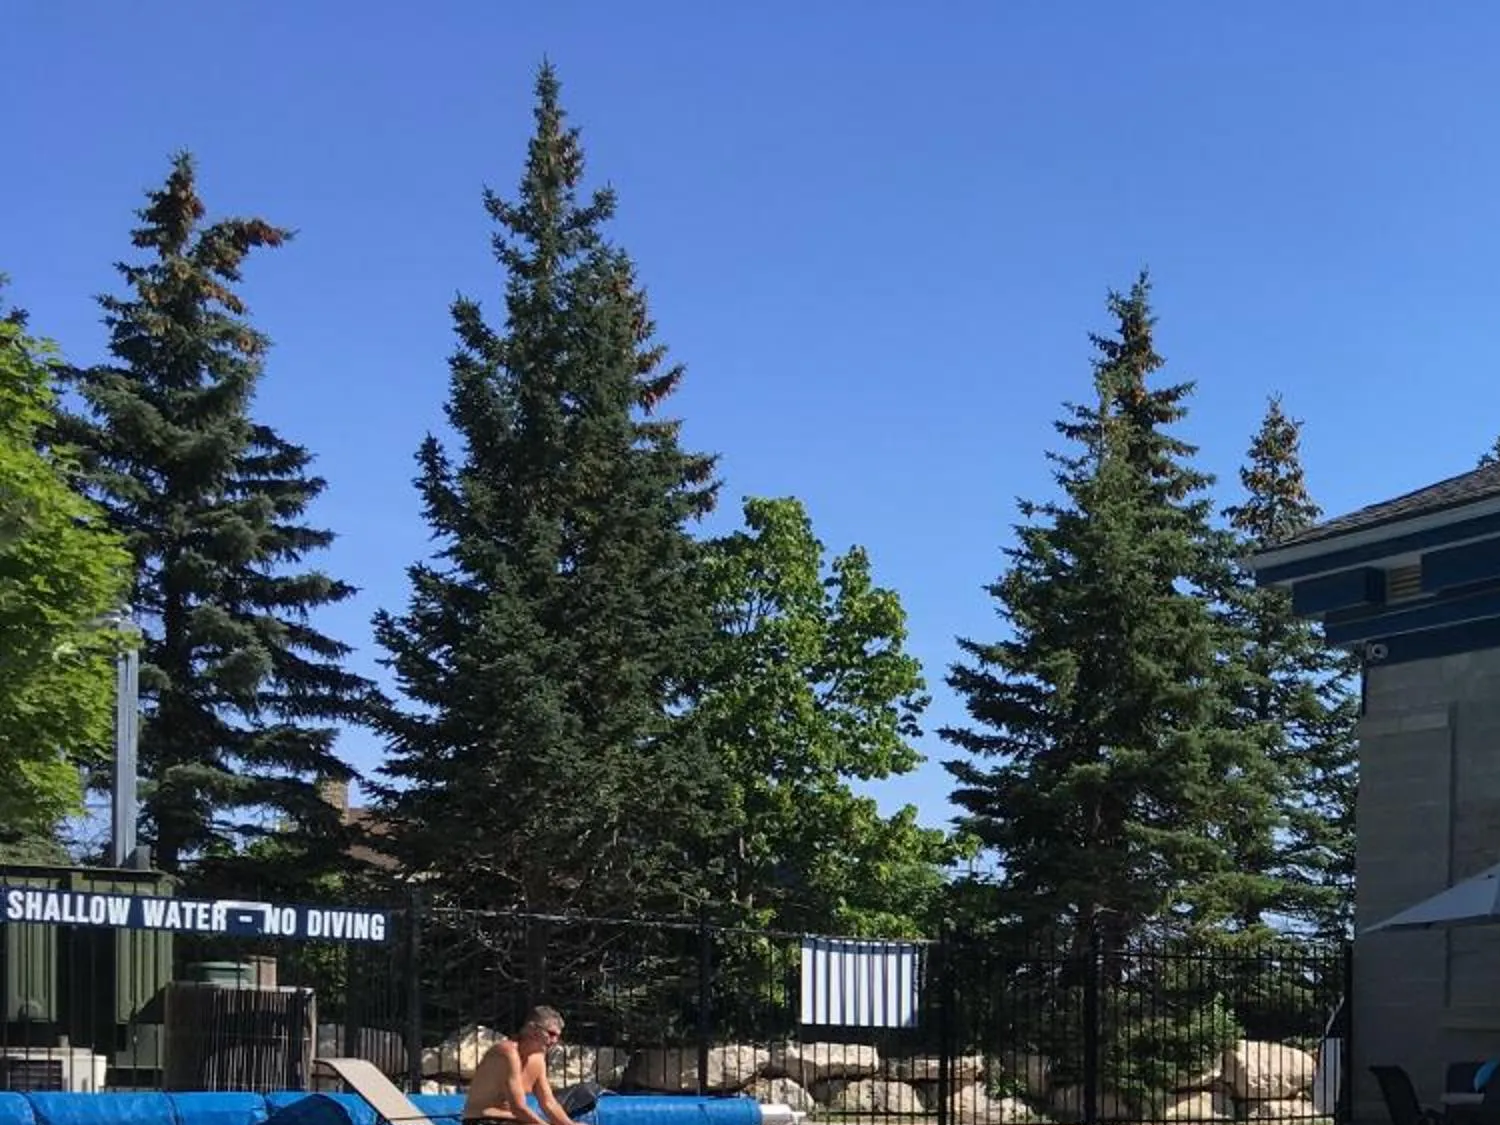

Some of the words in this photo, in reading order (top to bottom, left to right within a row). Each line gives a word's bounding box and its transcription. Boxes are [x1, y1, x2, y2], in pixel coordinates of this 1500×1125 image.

[7, 889, 130, 926] SHALLOW
[142, 899, 228, 932] WATER
[263, 908, 297, 936] NO
[306, 912, 386, 941] DIVING
